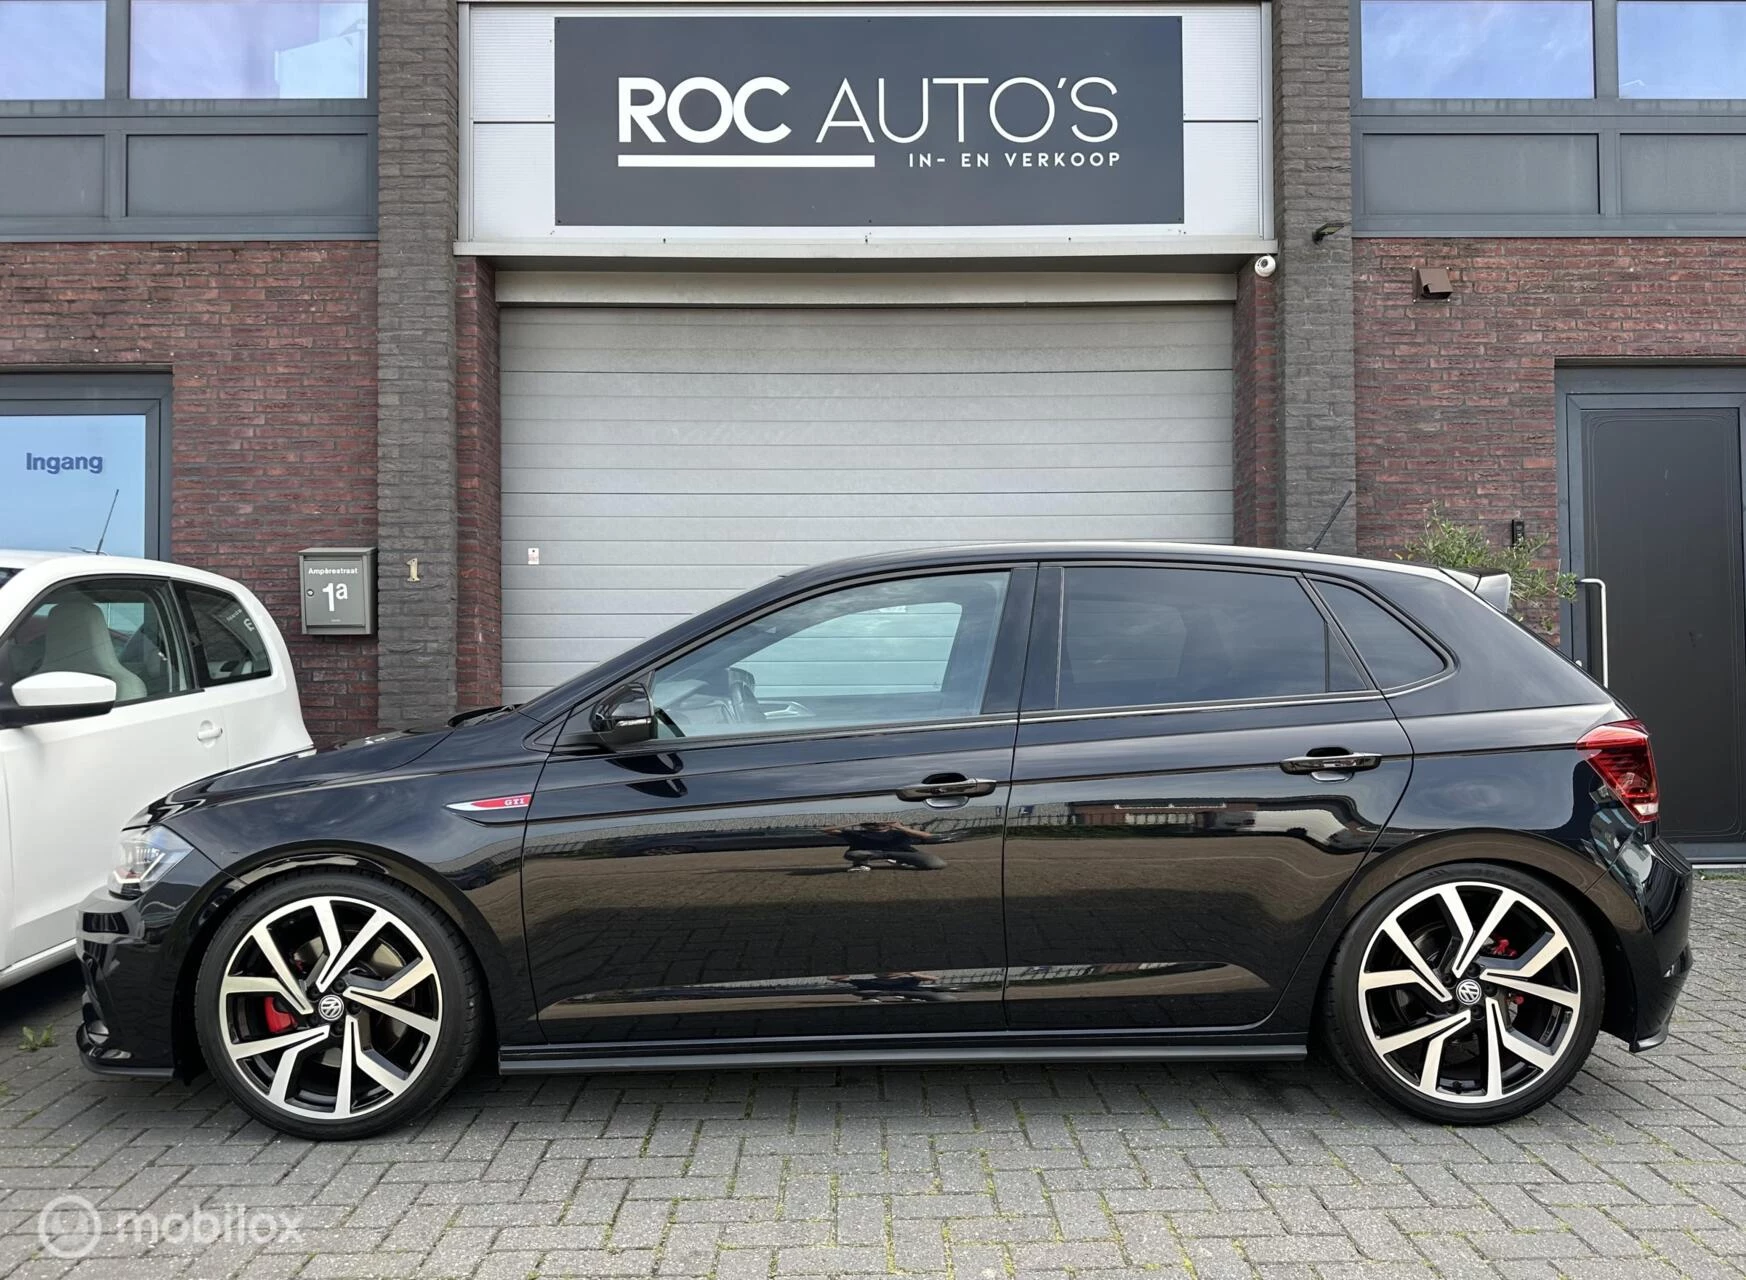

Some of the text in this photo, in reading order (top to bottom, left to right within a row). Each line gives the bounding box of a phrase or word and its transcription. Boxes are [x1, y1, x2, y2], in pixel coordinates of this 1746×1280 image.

[618, 76, 1119, 144] ROC AUTO'S
[909, 151, 1121, 168] IN- EN VERKOOP
[26, 452, 103, 475] Ingang
[406, 558, 420, 581] 1
[322, 582, 348, 612] 1a
[504, 798, 525, 806] GTI
